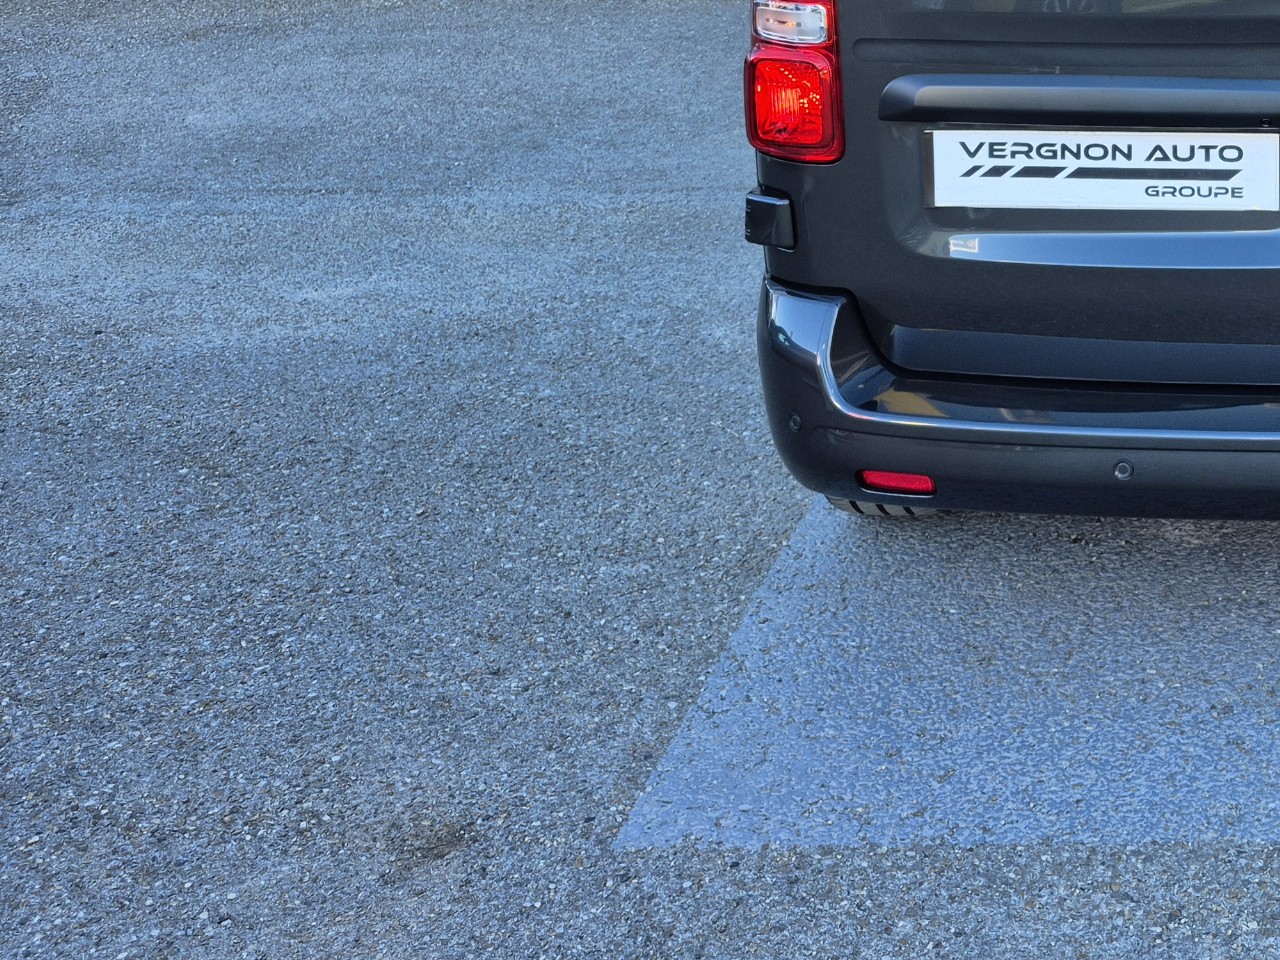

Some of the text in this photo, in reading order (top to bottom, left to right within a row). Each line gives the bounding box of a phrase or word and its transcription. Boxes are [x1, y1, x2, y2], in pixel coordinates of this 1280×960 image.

[959, 142, 1244, 163] VERGNON AUTO
[1144, 185, 1244, 199] GROUPE
